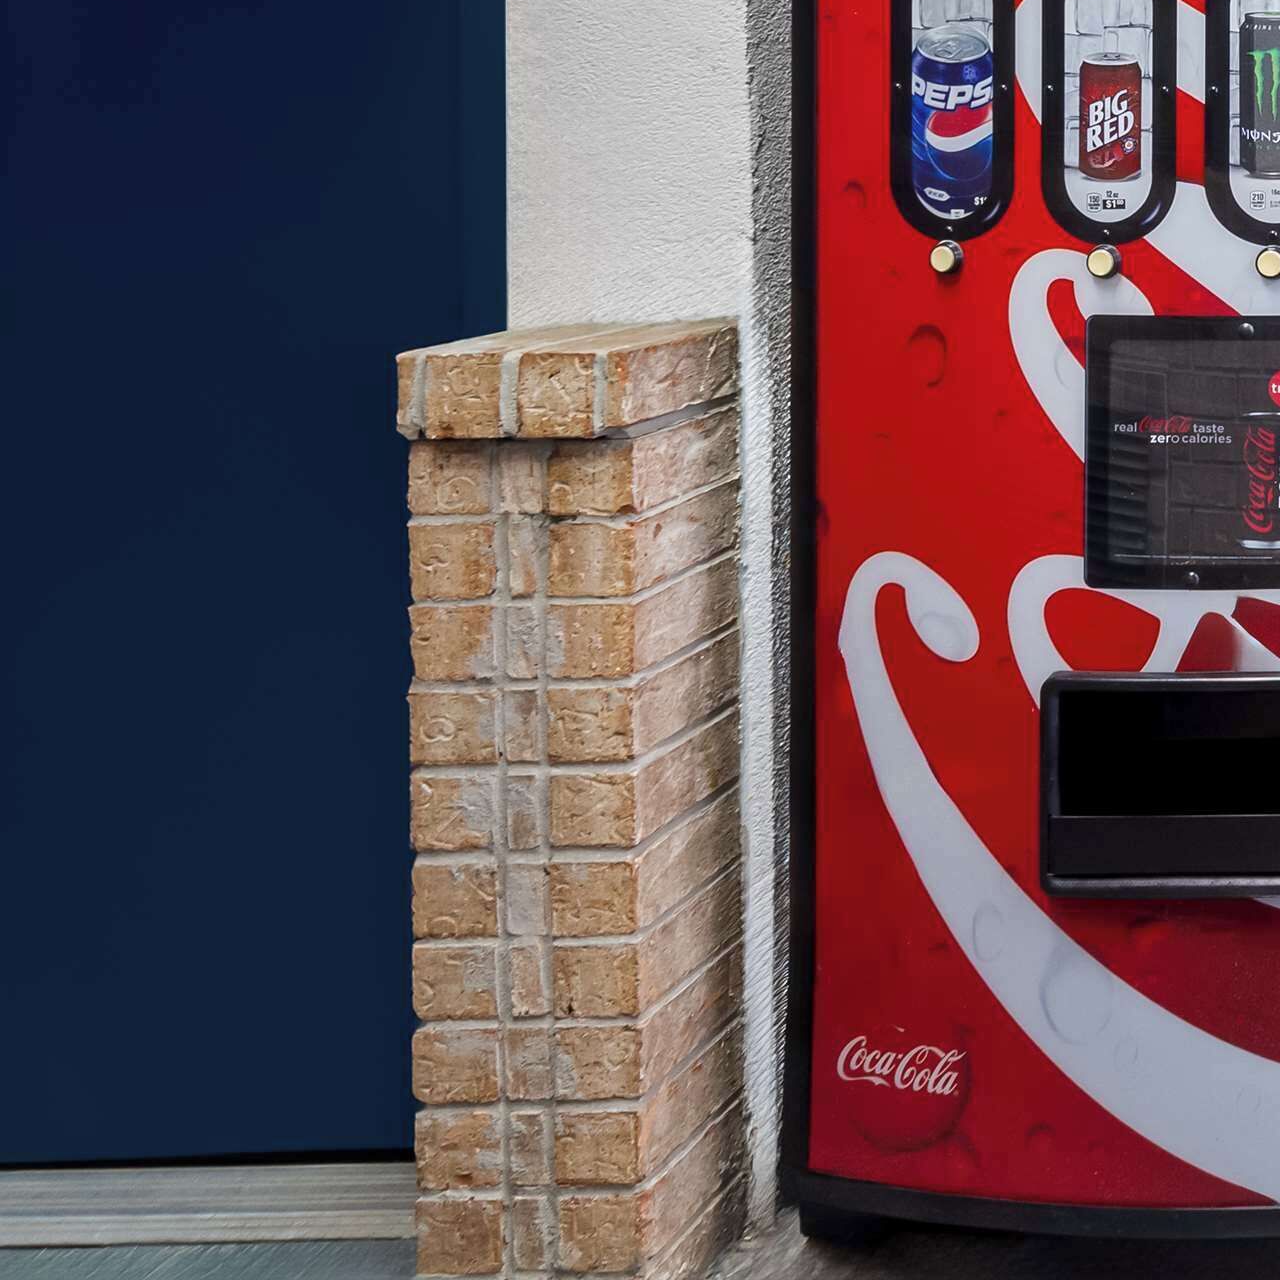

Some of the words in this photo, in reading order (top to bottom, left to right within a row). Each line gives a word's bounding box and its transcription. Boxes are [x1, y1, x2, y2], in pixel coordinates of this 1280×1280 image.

[911, 72, 993, 110] PEPS
[1089, 89, 1128, 127] BIG
[1086, 110, 1134, 153] RED
[1251, 193, 1264, 201] 210
[1114, 422, 1138, 433] real
[1192, 423, 1225, 433] taste
[1149, 434, 1180, 444] zero
[1181, 433, 1233, 444] calories
[836, 1035, 967, 1096] Coca-Cola
